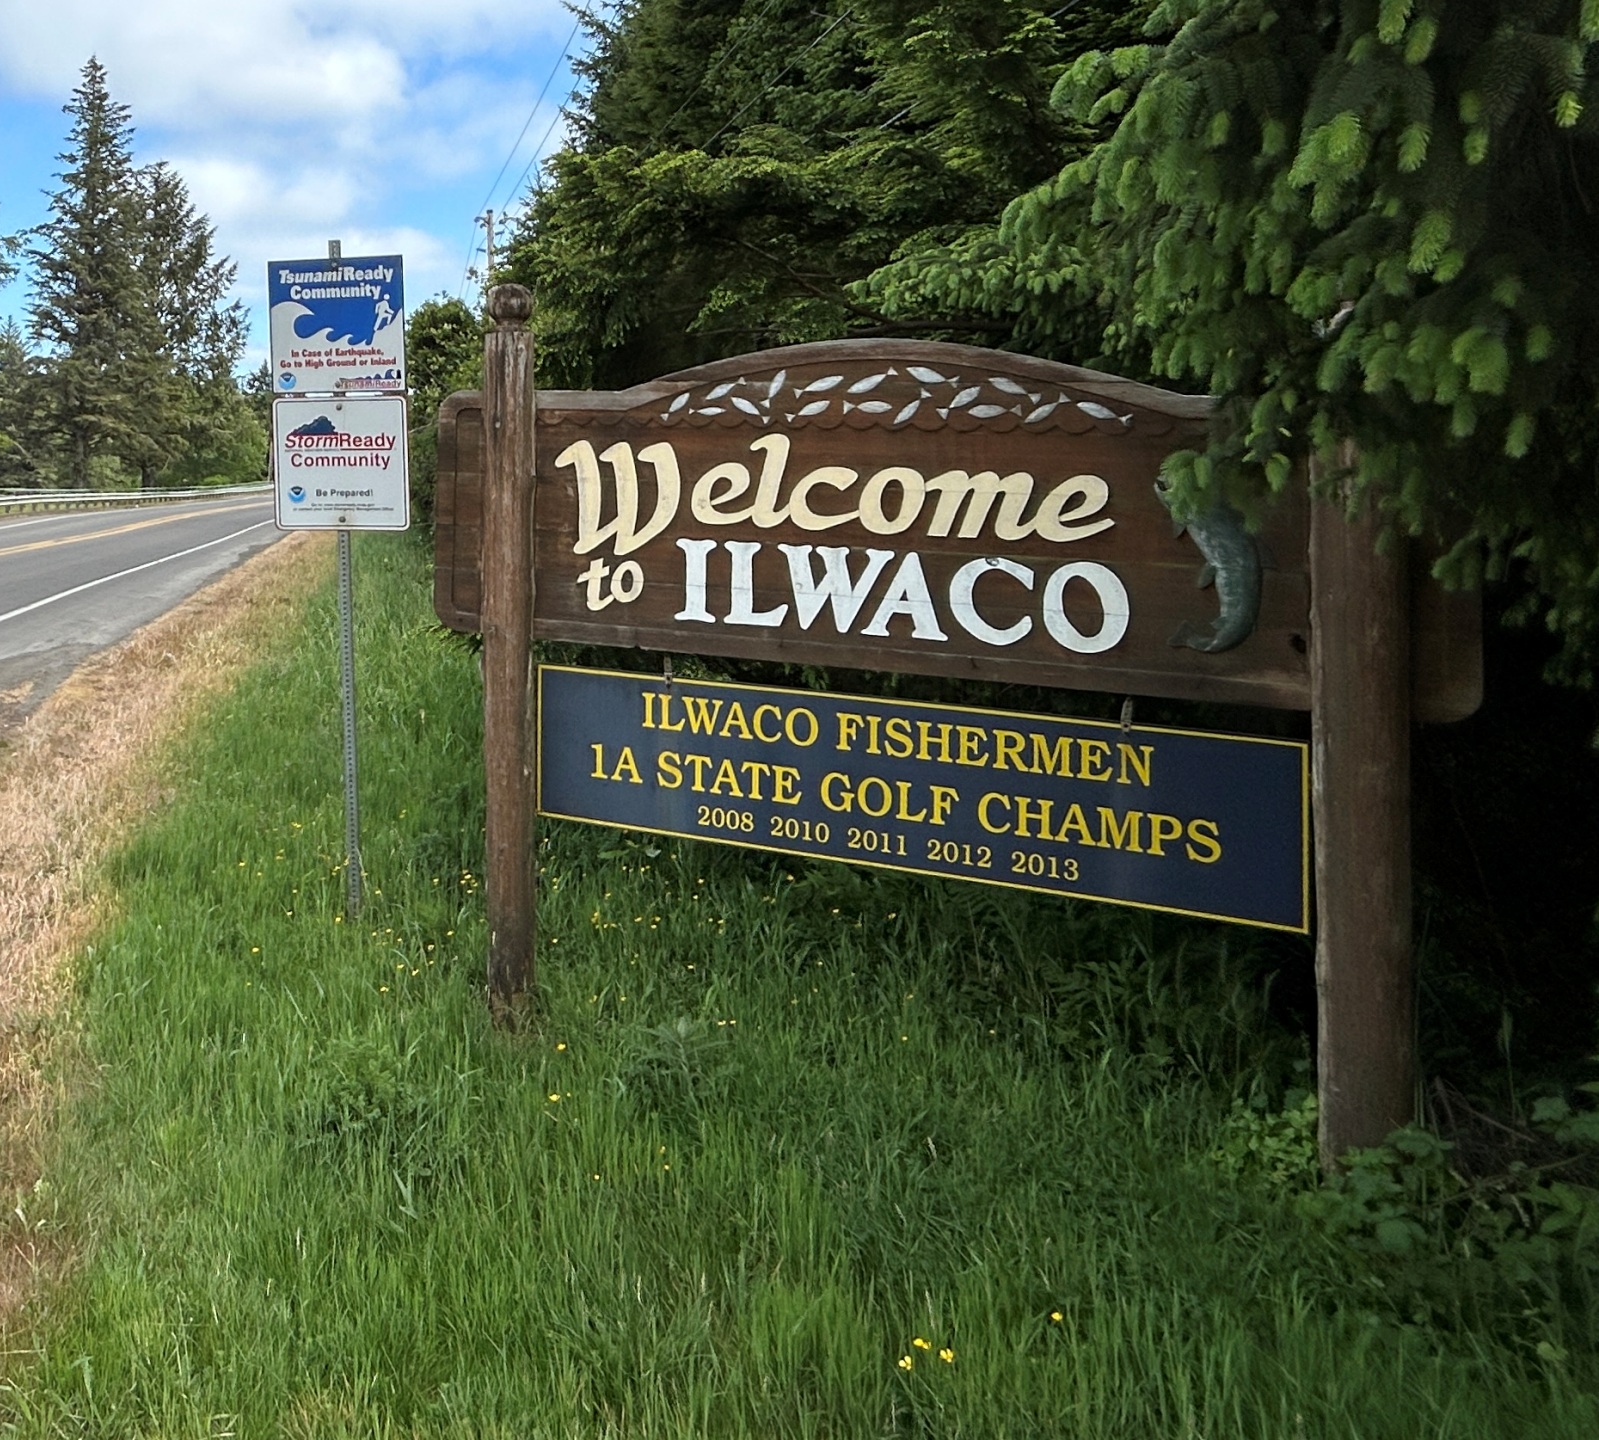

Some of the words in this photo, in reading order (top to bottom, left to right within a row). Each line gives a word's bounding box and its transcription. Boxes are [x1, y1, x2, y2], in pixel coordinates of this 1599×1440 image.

[279, 265, 393, 283] TsunamiReady
[290, 283, 381, 300] Community
[291, 349, 299, 358] In
[302, 349, 322, 358] Case
[324, 348, 333, 357] of
[280, 360, 292, 368] Go
[294, 360, 302, 368] to
[305, 359, 324, 369] High
[326, 358, 356, 367] Ground
[370, 357, 397, 366] Inland
[285, 432, 396, 450] StormReady
[291, 452, 390, 470] Community
[315, 489, 328, 497] Be
[330, 489, 374, 499] Prepared!
[554, 433, 1116, 555] Welcome
[576, 557, 644, 611] to
[674, 538, 1130, 654] ILWACO
[642, 692, 819, 747] ILWACO
[836, 712, 1154, 787] FISHERMEN
[590, 743, 643, 784] 1A
[657, 751, 802, 805] STATE
[820, 772, 960, 825] GOLF
[977, 792, 1223, 863] CHAMPS
[698, 806, 755, 832] 2008
[770, 816, 830, 843] 2010
[848, 827, 907, 855] 2011
[927, 839, 992, 868] 2012
[1011, 851, 1080, 881] 2013
